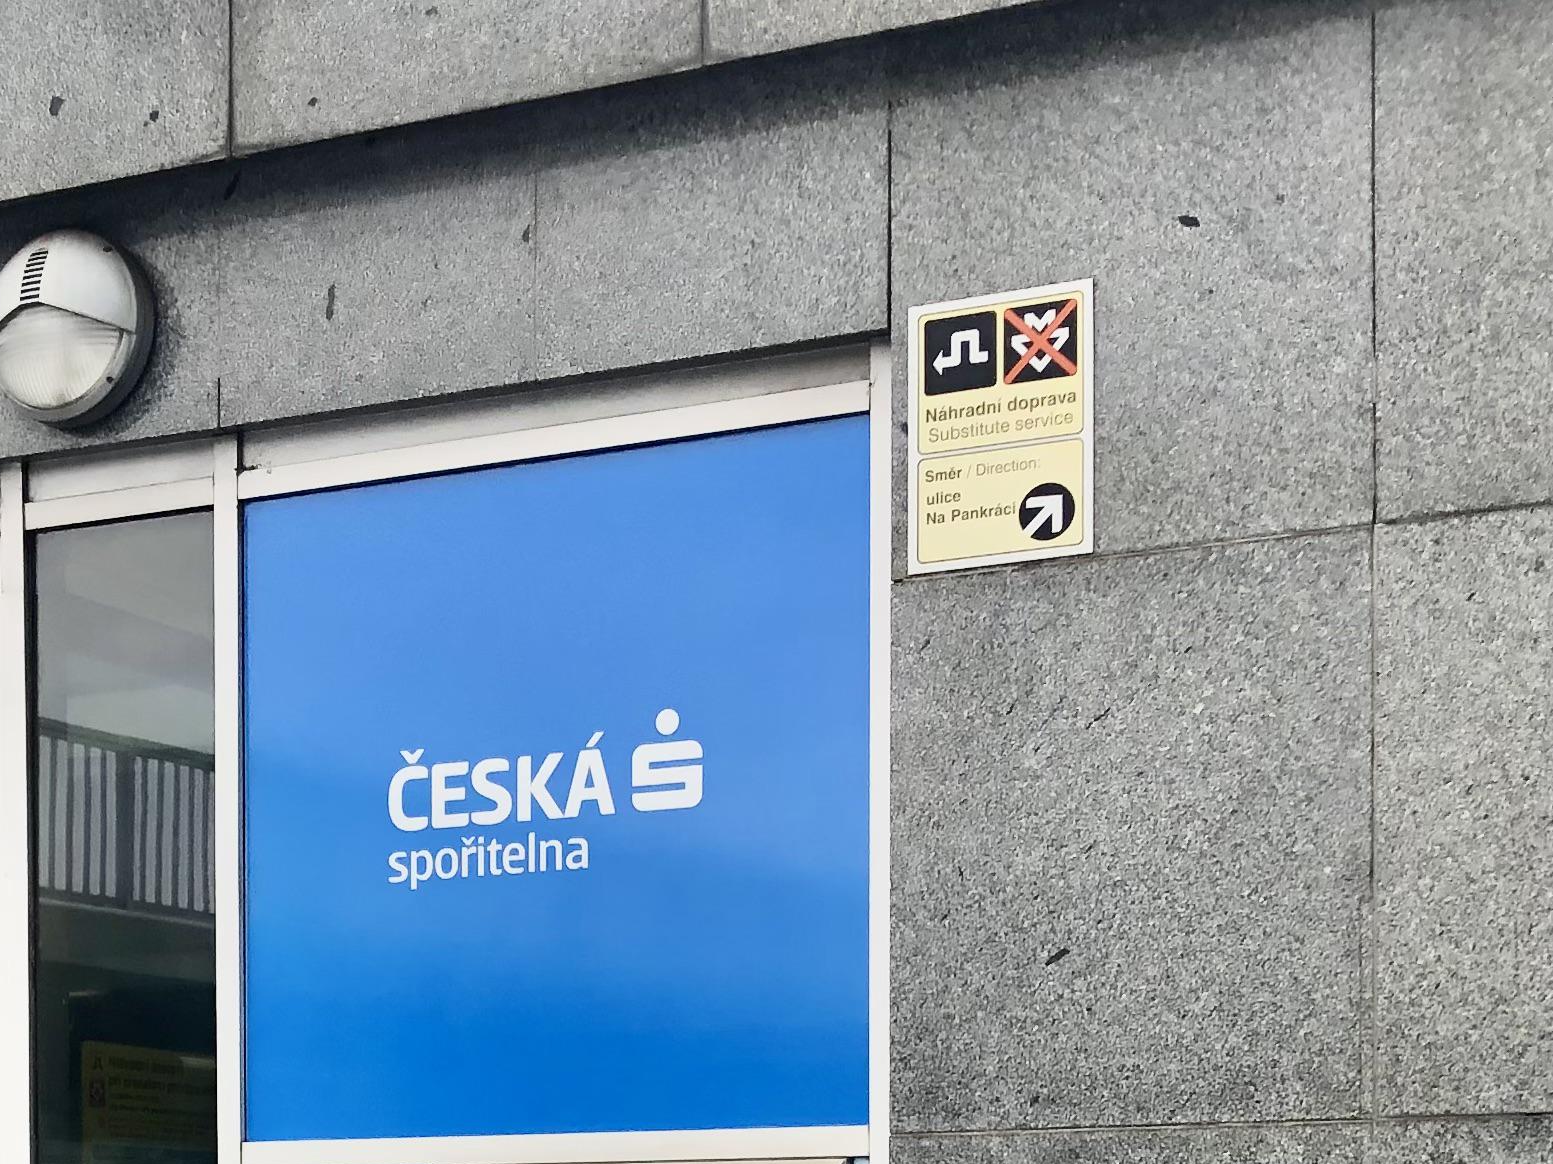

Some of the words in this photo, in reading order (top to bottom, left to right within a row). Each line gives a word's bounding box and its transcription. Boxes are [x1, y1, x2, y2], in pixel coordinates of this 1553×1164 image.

[925, 397, 1002, 423] Náhradní
[1007, 391, 1077, 413] doprava
[928, 421, 1010, 443] Substitute
[1014, 411, 1074, 431] service
[926, 491, 961, 506] ulice
[926, 511, 945, 525] Na
[387, 730, 616, 832] ČESKÁ
[387, 831, 590, 891] spořitelna
